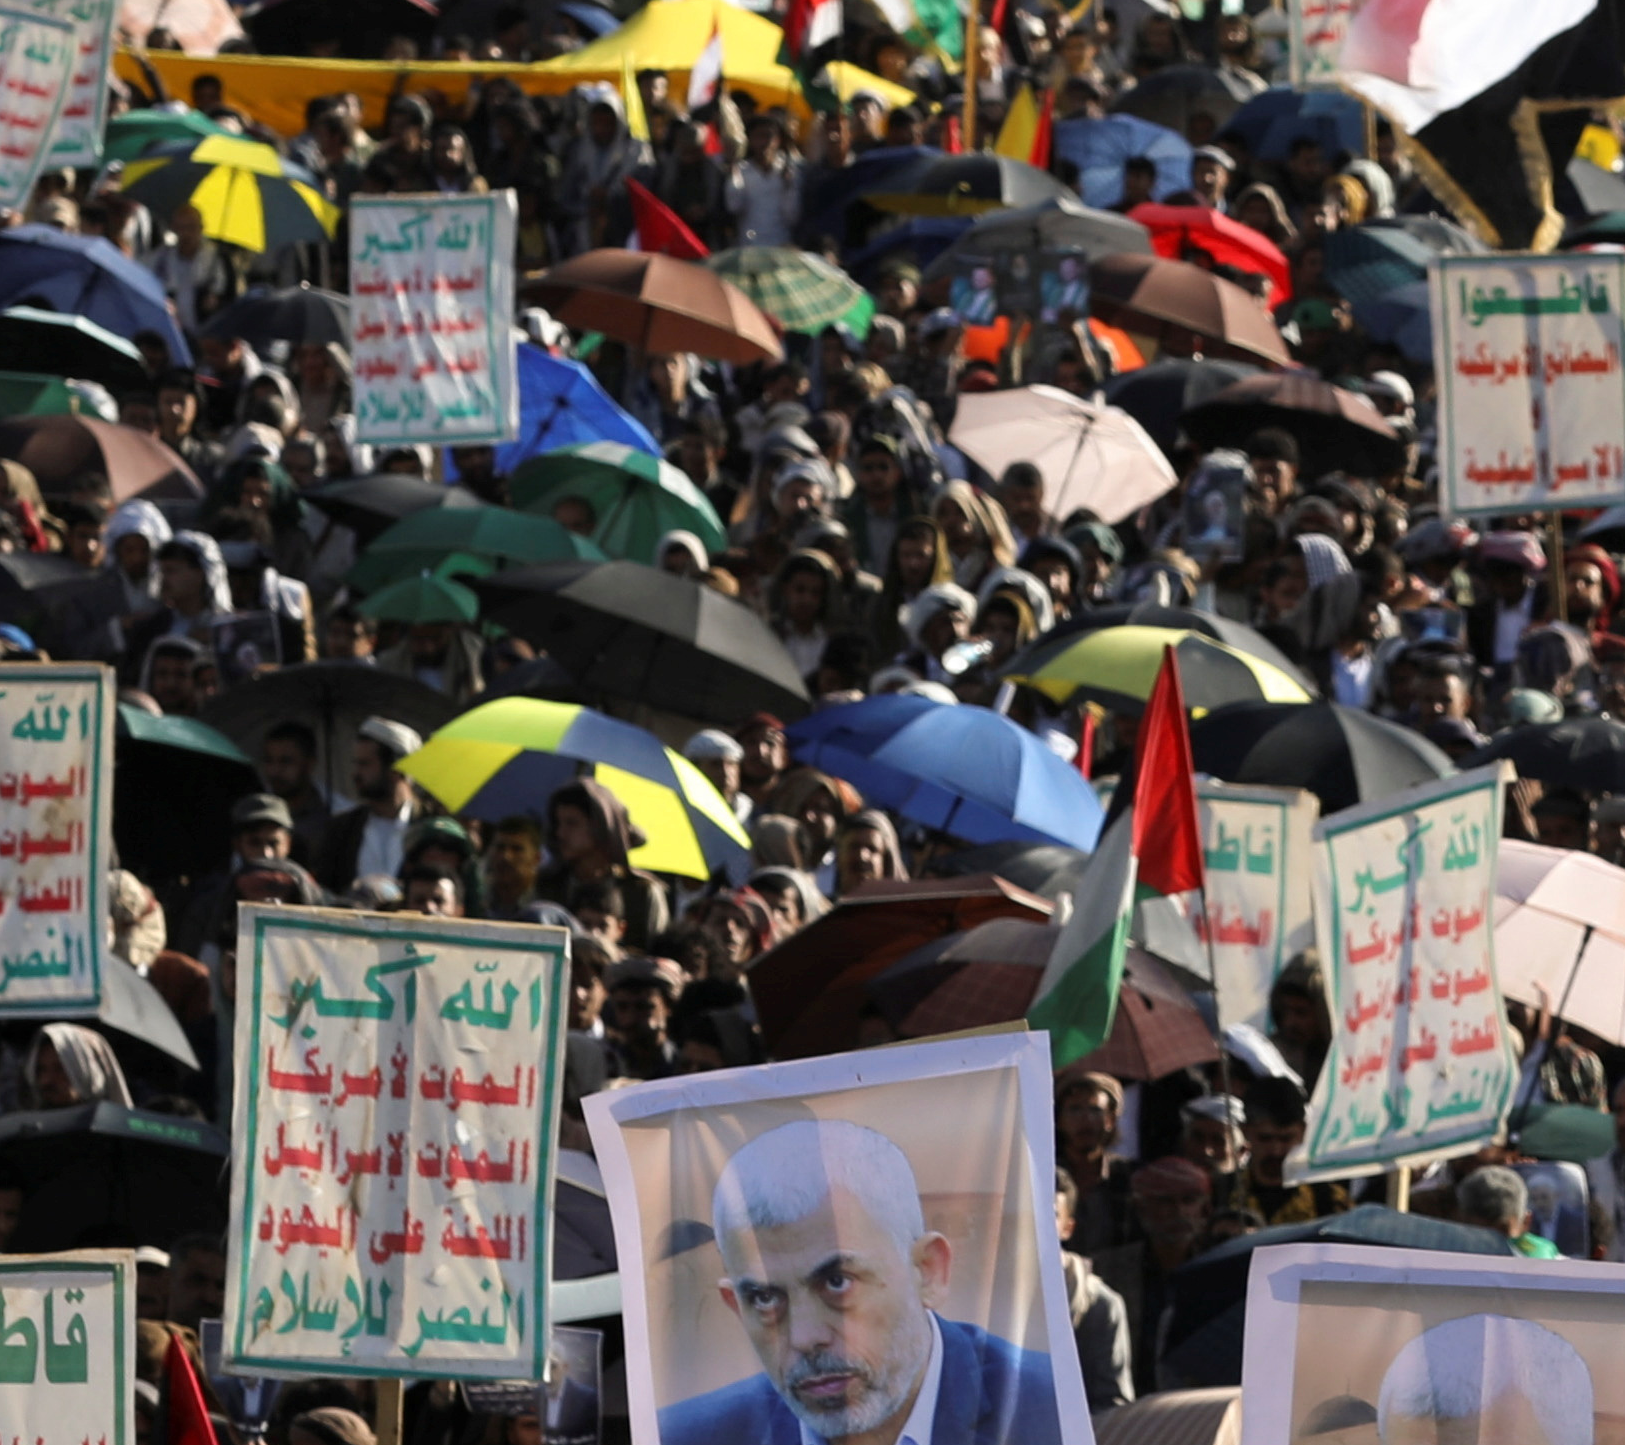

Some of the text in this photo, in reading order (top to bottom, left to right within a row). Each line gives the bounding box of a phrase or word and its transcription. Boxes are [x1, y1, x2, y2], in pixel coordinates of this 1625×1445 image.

[12, 695, 90, 742] الله
[0, 767, 86, 806] الموت
[20, 880, 82, 913] اللعنة
[270, 945, 542, 1030] الله أكبر
[267, 1047, 536, 1109] الموت لأمريكا
[264, 1123, 530, 1189] الموت لإسرائيل
[259, 1205, 523, 1264] اللعنة على اليهود
[252, 1271, 526, 1357] النصر للإسلام
